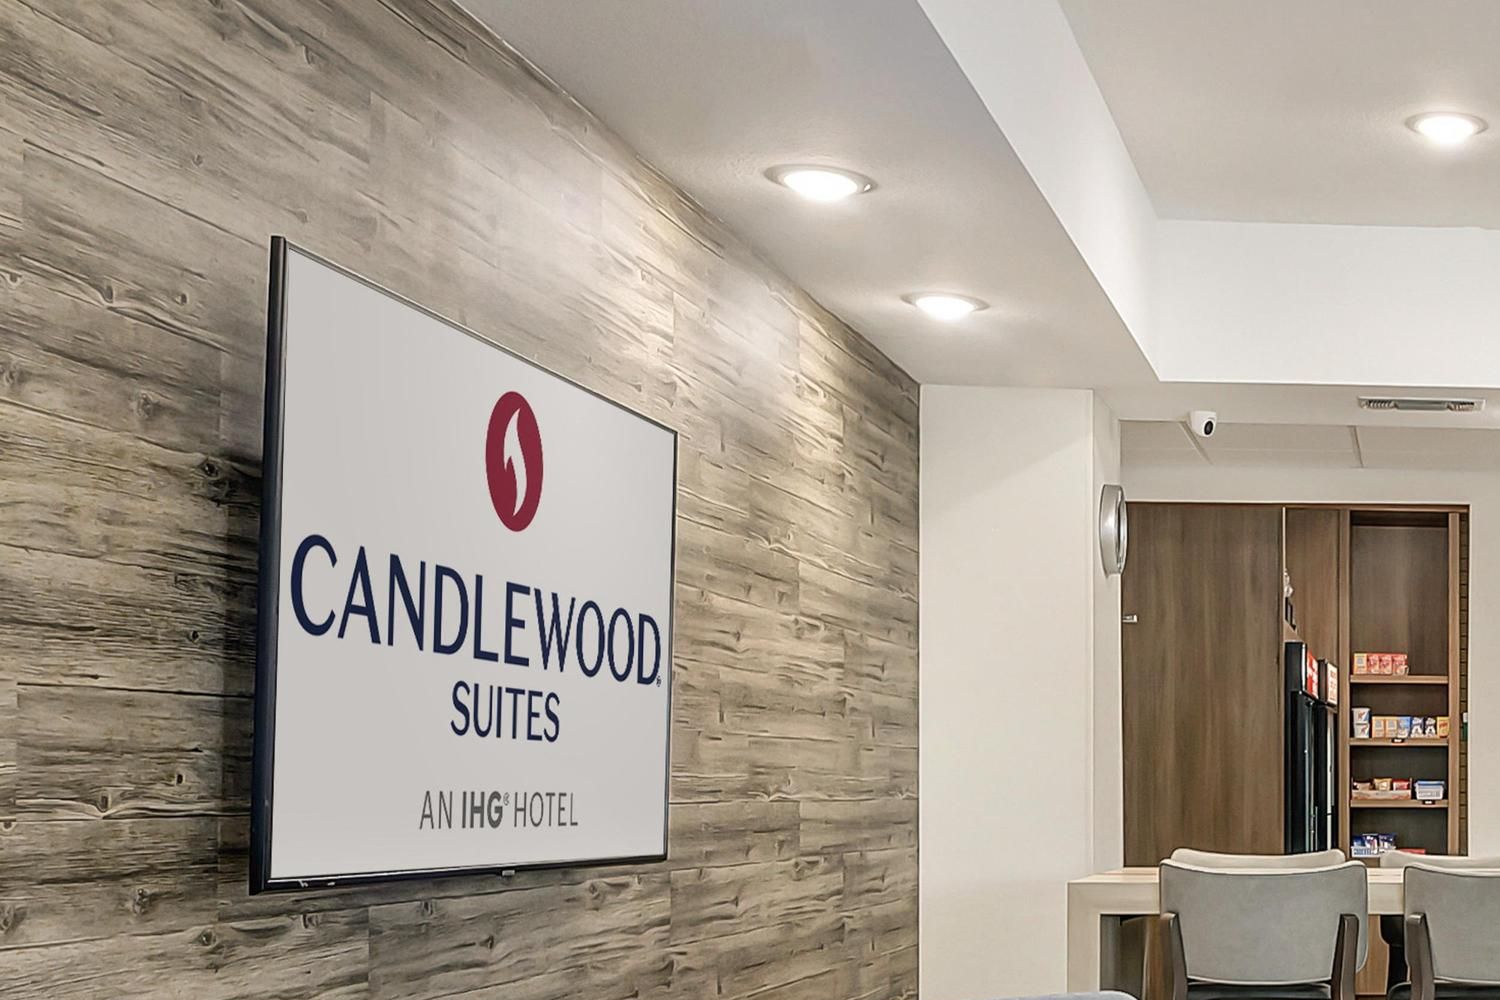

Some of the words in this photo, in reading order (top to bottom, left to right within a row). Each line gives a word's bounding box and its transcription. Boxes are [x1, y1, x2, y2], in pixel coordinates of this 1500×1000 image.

[290, 534, 662, 686] CANDLEWOOD
[450, 680, 561, 743] SUITES
[419, 790, 453, 830] AN
[513, 791, 579, 828] HOTEL
